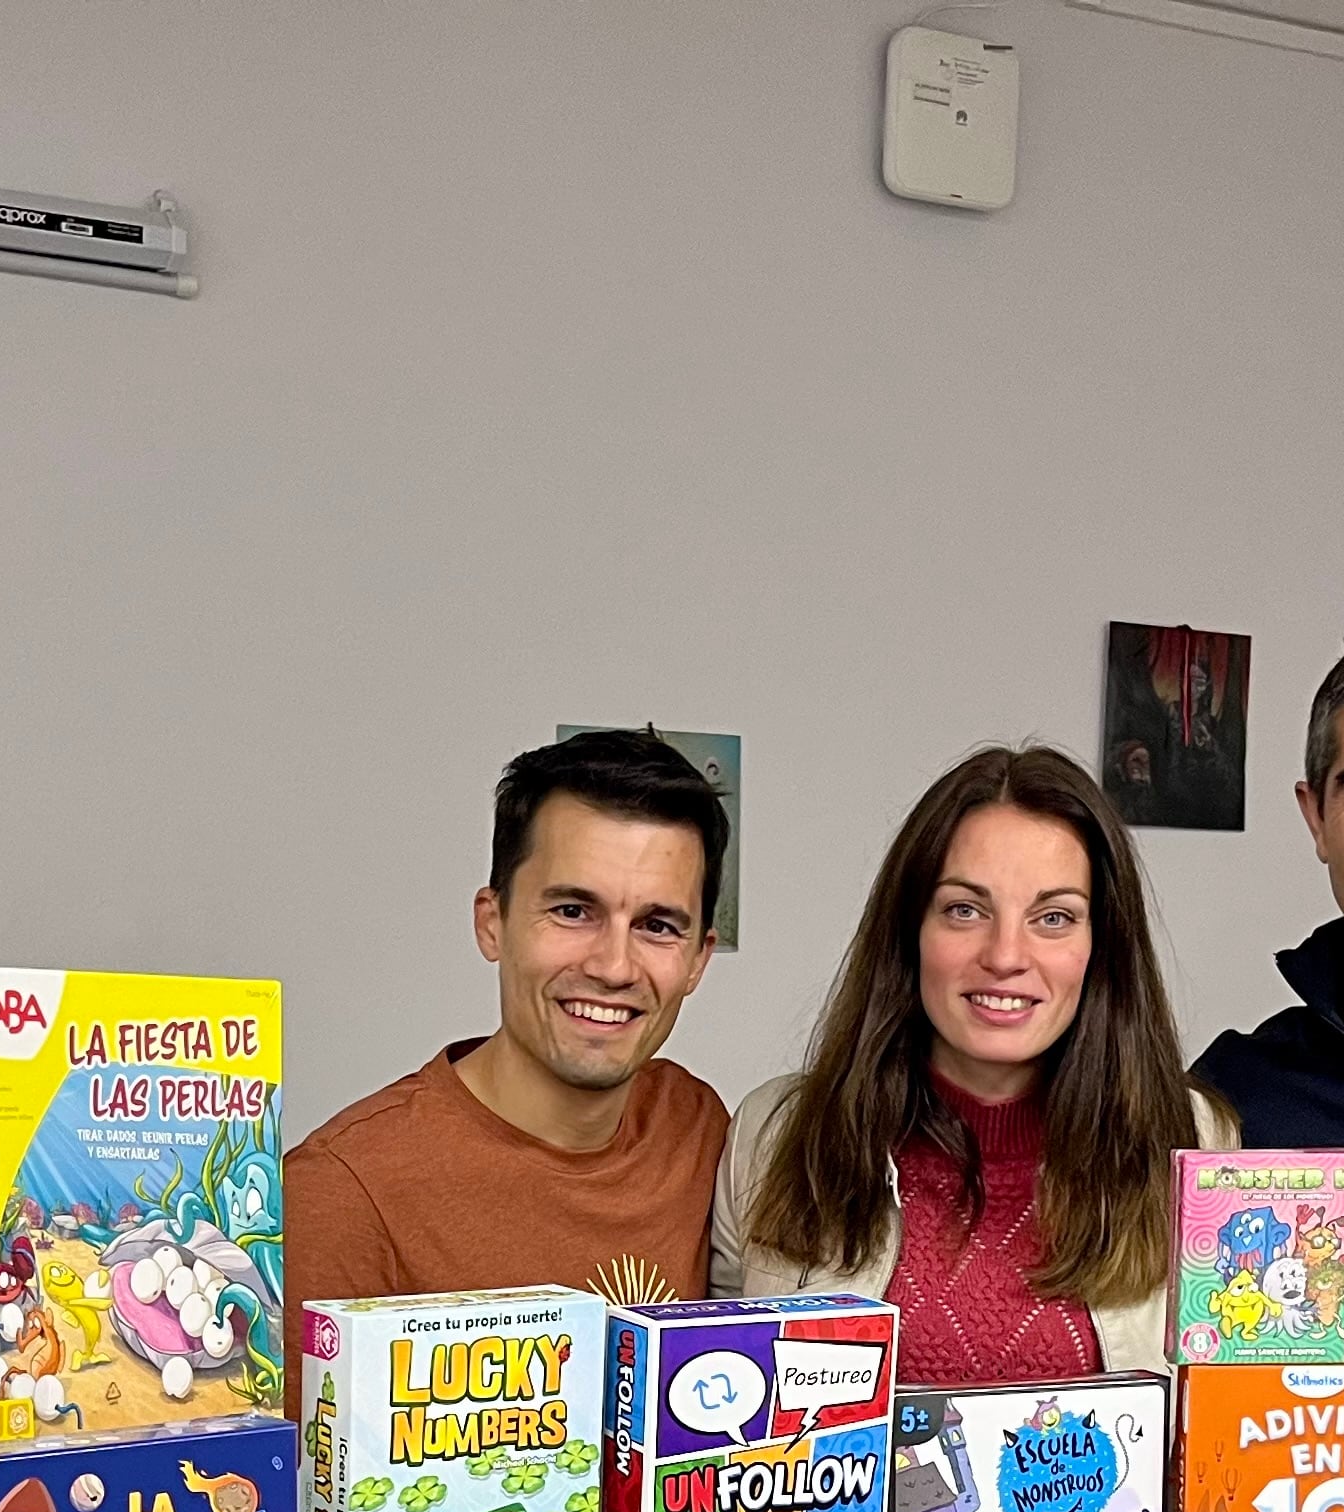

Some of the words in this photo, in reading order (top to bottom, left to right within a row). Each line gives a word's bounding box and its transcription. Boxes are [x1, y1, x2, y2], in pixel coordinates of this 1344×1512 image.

[69, 1025, 105, 1065] LA
[119, 1021, 212, 1063] FIESTA
[222, 1019, 258, 1057] DE
[92, 1079, 149, 1117] LAS
[158, 1080, 264, 1117] PERLAS
[446, 1317, 461, 1329] tu
[465, 1312, 513, 1333] propia
[516, 1309, 562, 1325] suerte!
[390, 1334, 572, 1406] LUCKY
[783, 1367, 872, 1386] Postureo
[616, 1330, 636, 1477] UNFOLLOW
[312, 1398, 337, 1503] LUCKY
[391, 1401, 567, 1466] NUMBERS
[1015, 1433, 1096, 1474] ESCUELA
[1051, 1461, 1066, 1474] de
[1290, 1443, 1341, 1475] EN
